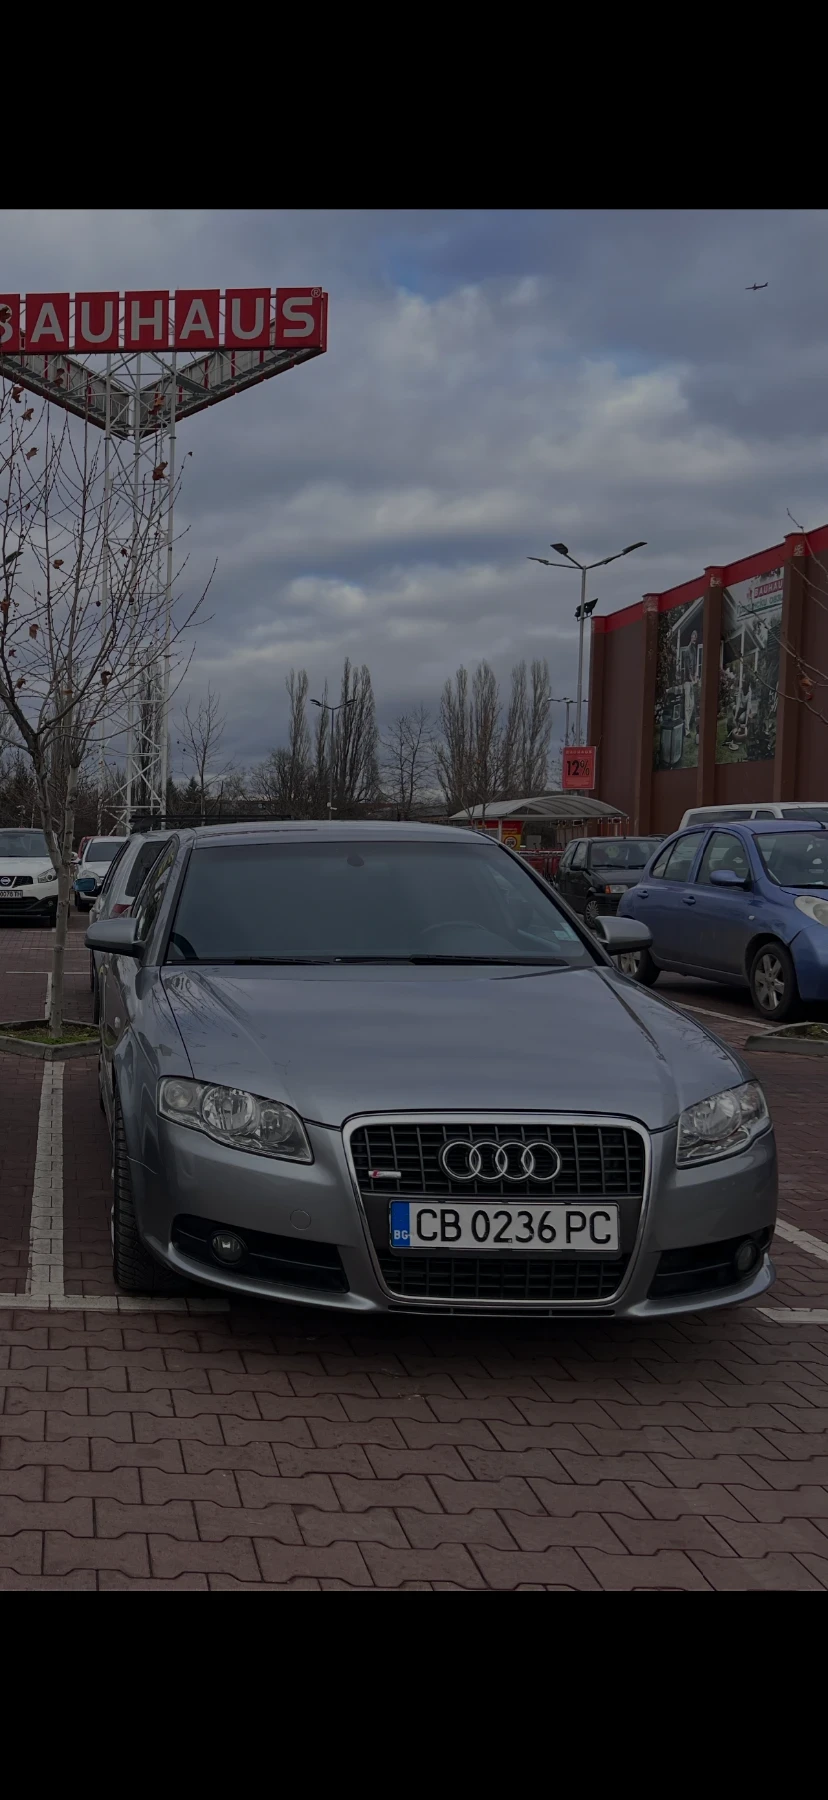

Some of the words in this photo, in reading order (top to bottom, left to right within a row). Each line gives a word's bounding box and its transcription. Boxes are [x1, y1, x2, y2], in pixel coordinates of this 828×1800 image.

[754, 580, 783, 597] BAUHAU
[566, 760, 590, 776] 12%
[393, 1230, 409, 1240] BG
[416, 1209, 462, 1243] CB
[471, 1210, 557, 1244] 0236
[565, 1211, 612, 1245] PC
